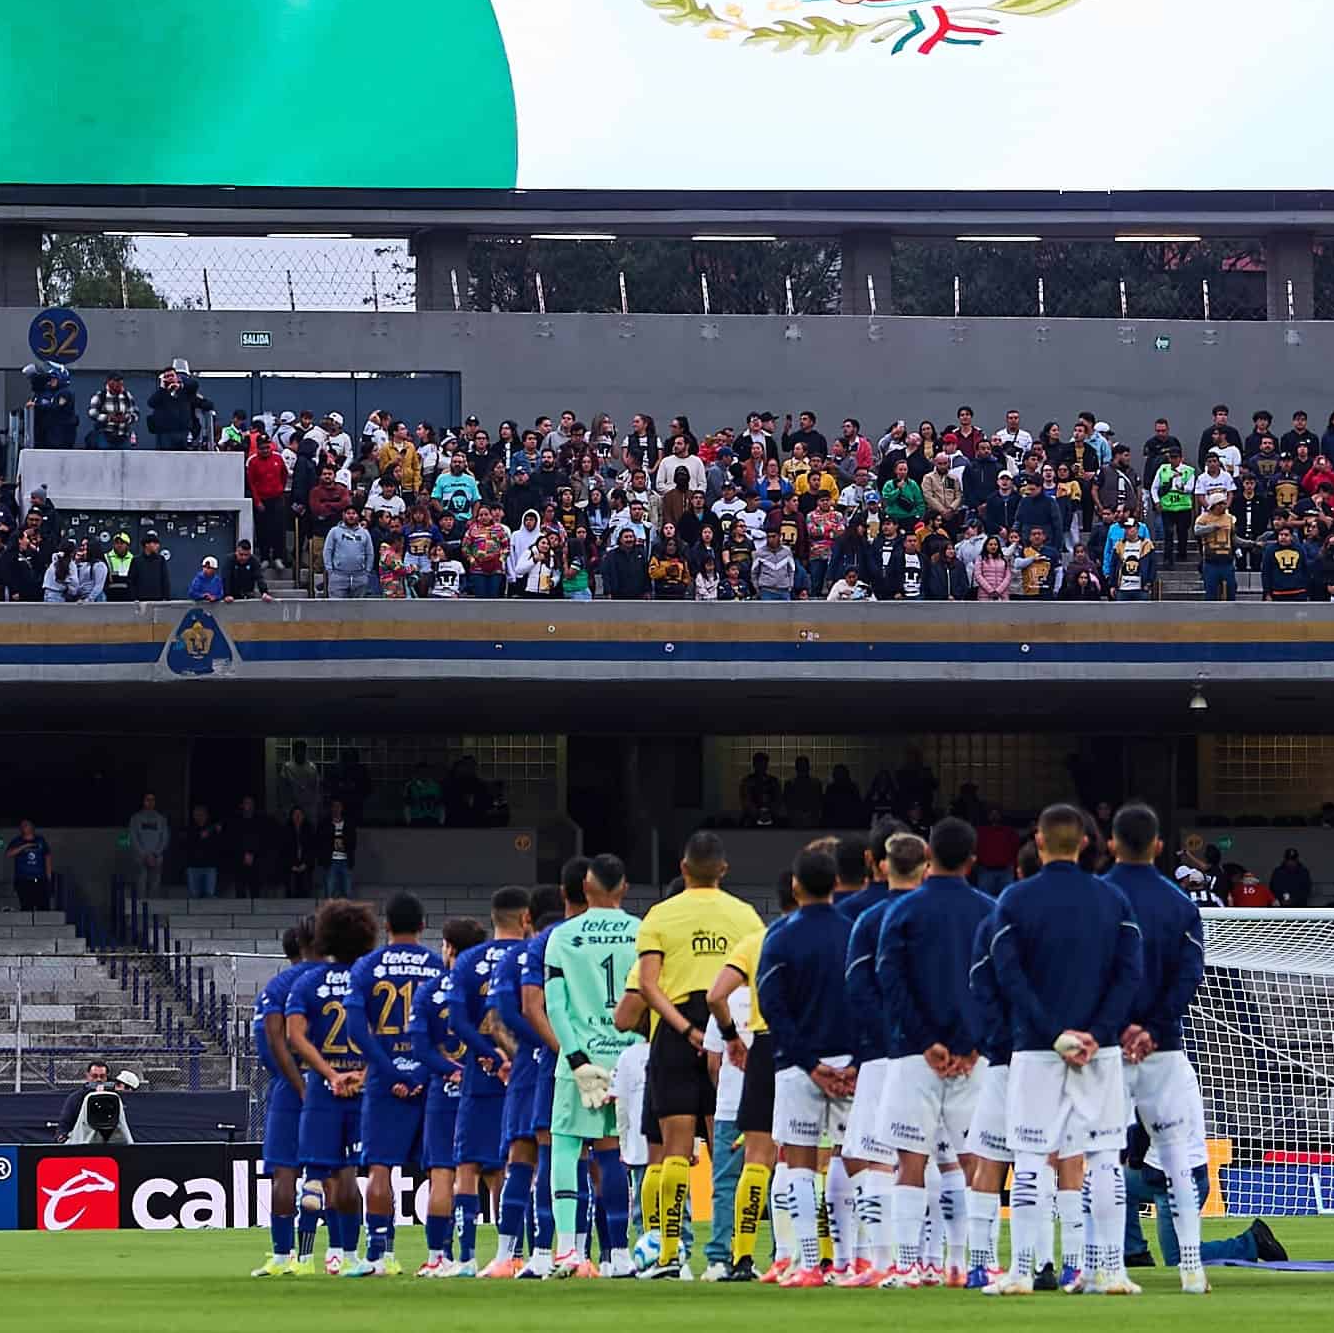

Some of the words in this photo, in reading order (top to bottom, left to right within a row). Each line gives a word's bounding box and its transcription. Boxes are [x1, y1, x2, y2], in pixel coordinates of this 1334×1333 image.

[38, 319, 80, 355] 32
[242, 334, 269, 345] SALIDA
[581, 918, 631, 933] telcel
[382, 951, 430, 965] telcel
[373, 980, 413, 1034] 21
[666, 1183, 687, 1238] Wilson
[740, 1185, 762, 1234] Wilson
